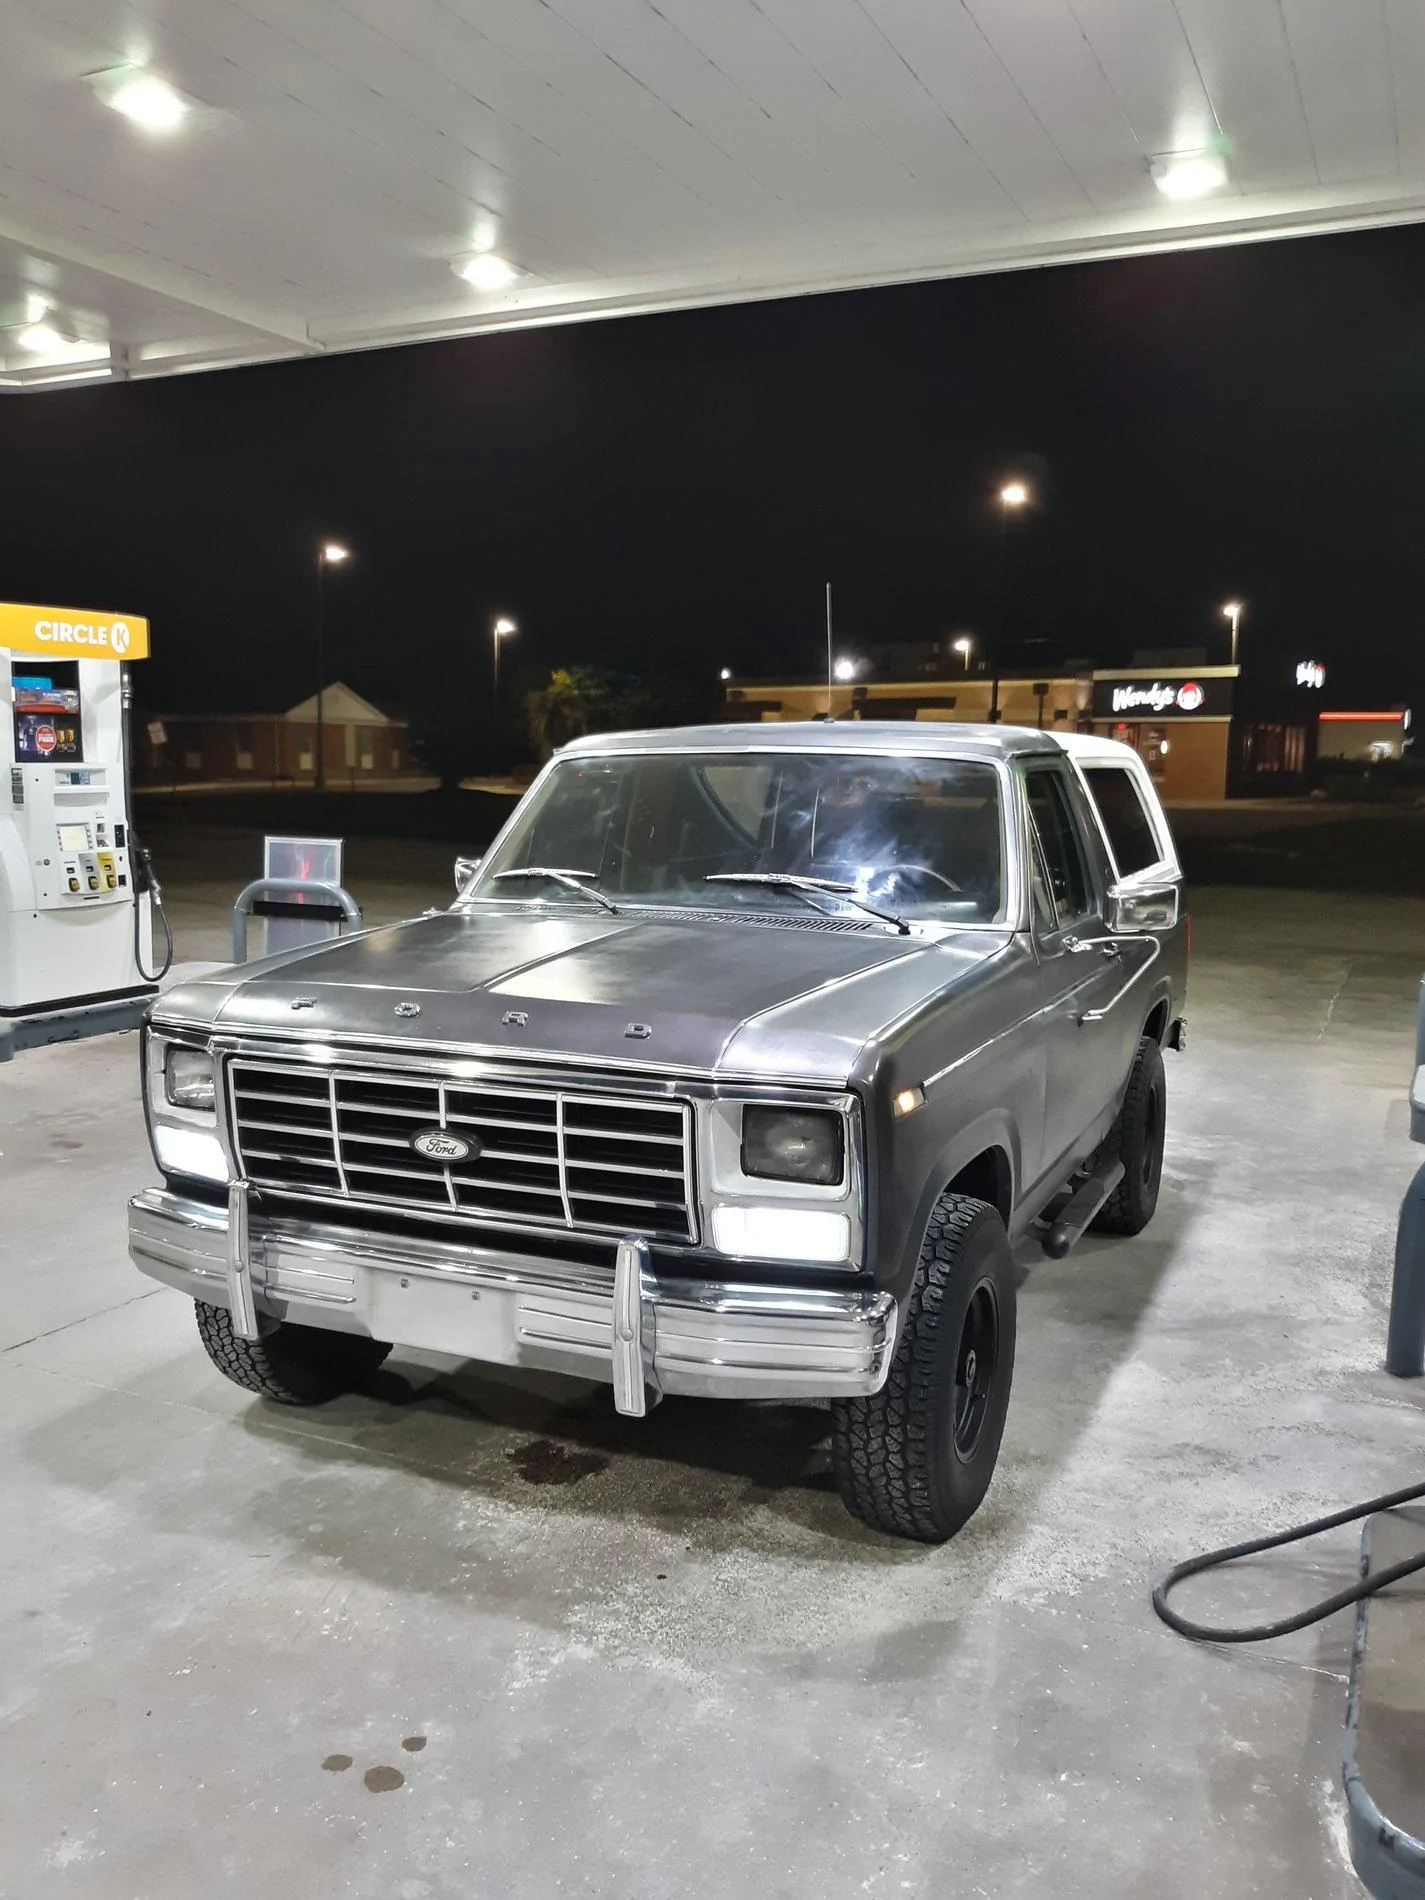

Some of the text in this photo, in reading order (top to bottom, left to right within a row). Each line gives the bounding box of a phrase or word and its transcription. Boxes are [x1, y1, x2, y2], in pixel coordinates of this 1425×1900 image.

[35, 620, 130, 653] CIRCLE K
[1112, 682, 1175, 712] Wendy's
[426, 1138, 458, 1156] Ford
